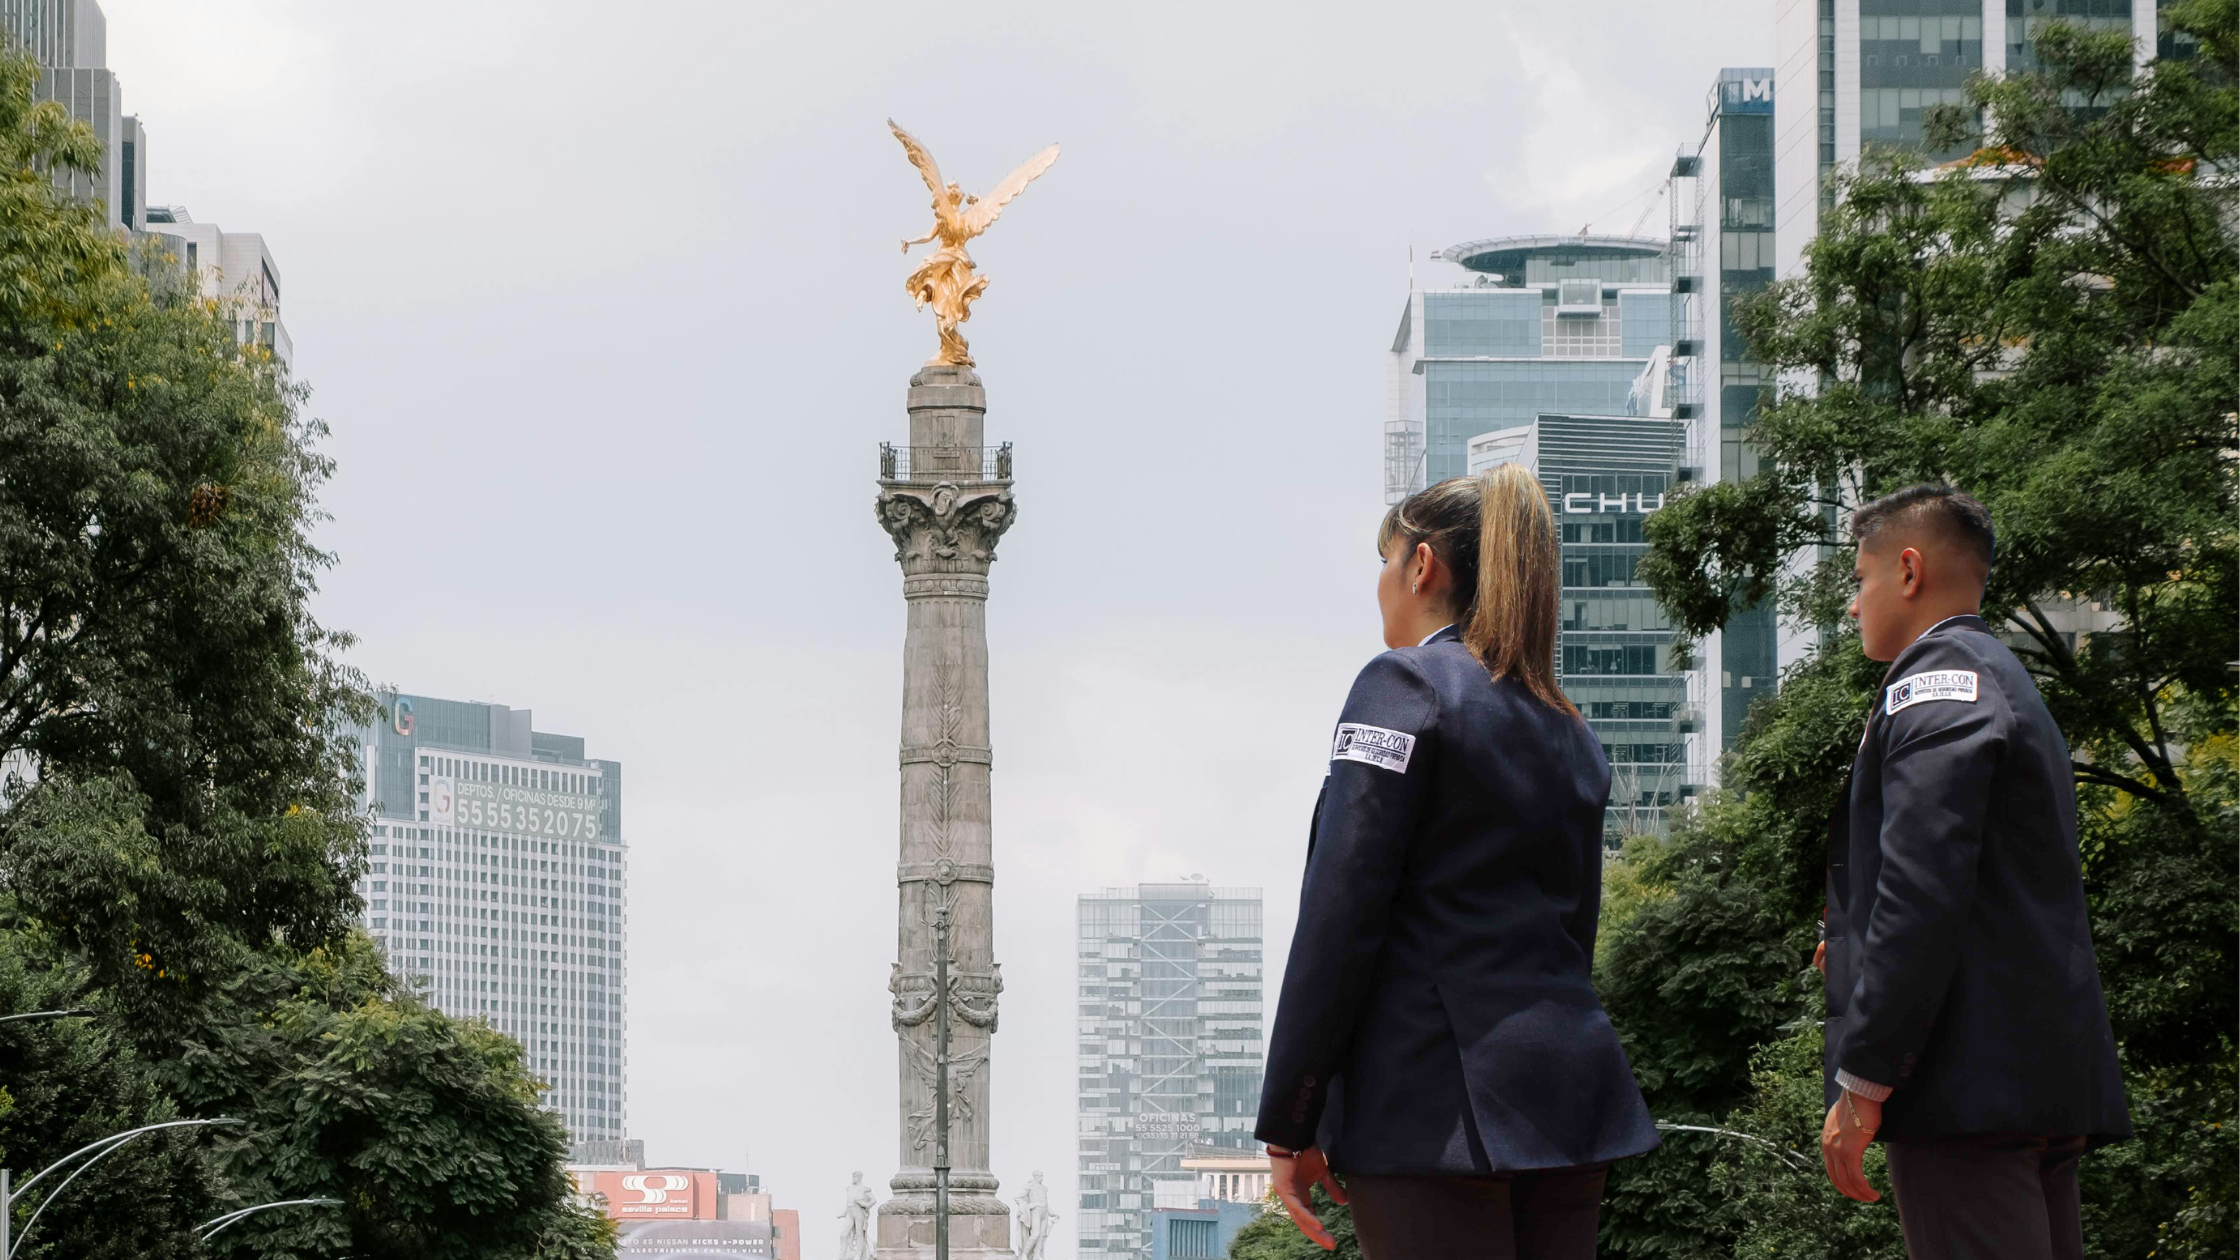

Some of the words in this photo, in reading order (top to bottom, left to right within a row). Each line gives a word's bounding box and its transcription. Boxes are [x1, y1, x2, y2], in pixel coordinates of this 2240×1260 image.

[1914, 673, 1974, 688] INTER-CON
[394, 697, 414, 736] G
[1355, 727, 1410, 752] INTER-CON
[503, 787, 546, 806] OFICINAS
[547, 793, 576, 810] DESDE
[577, 797, 584, 810] 9
[1139, 1113, 1196, 1123] OFICINAS
[1135, 1124, 1148, 1132] 55
[1150, 1124, 1173, 1132] 5525
[621, 1205, 653, 1213] sevilla
[655, 1205, 688, 1215] palace
[692, 1238, 719, 1246] KICKS
